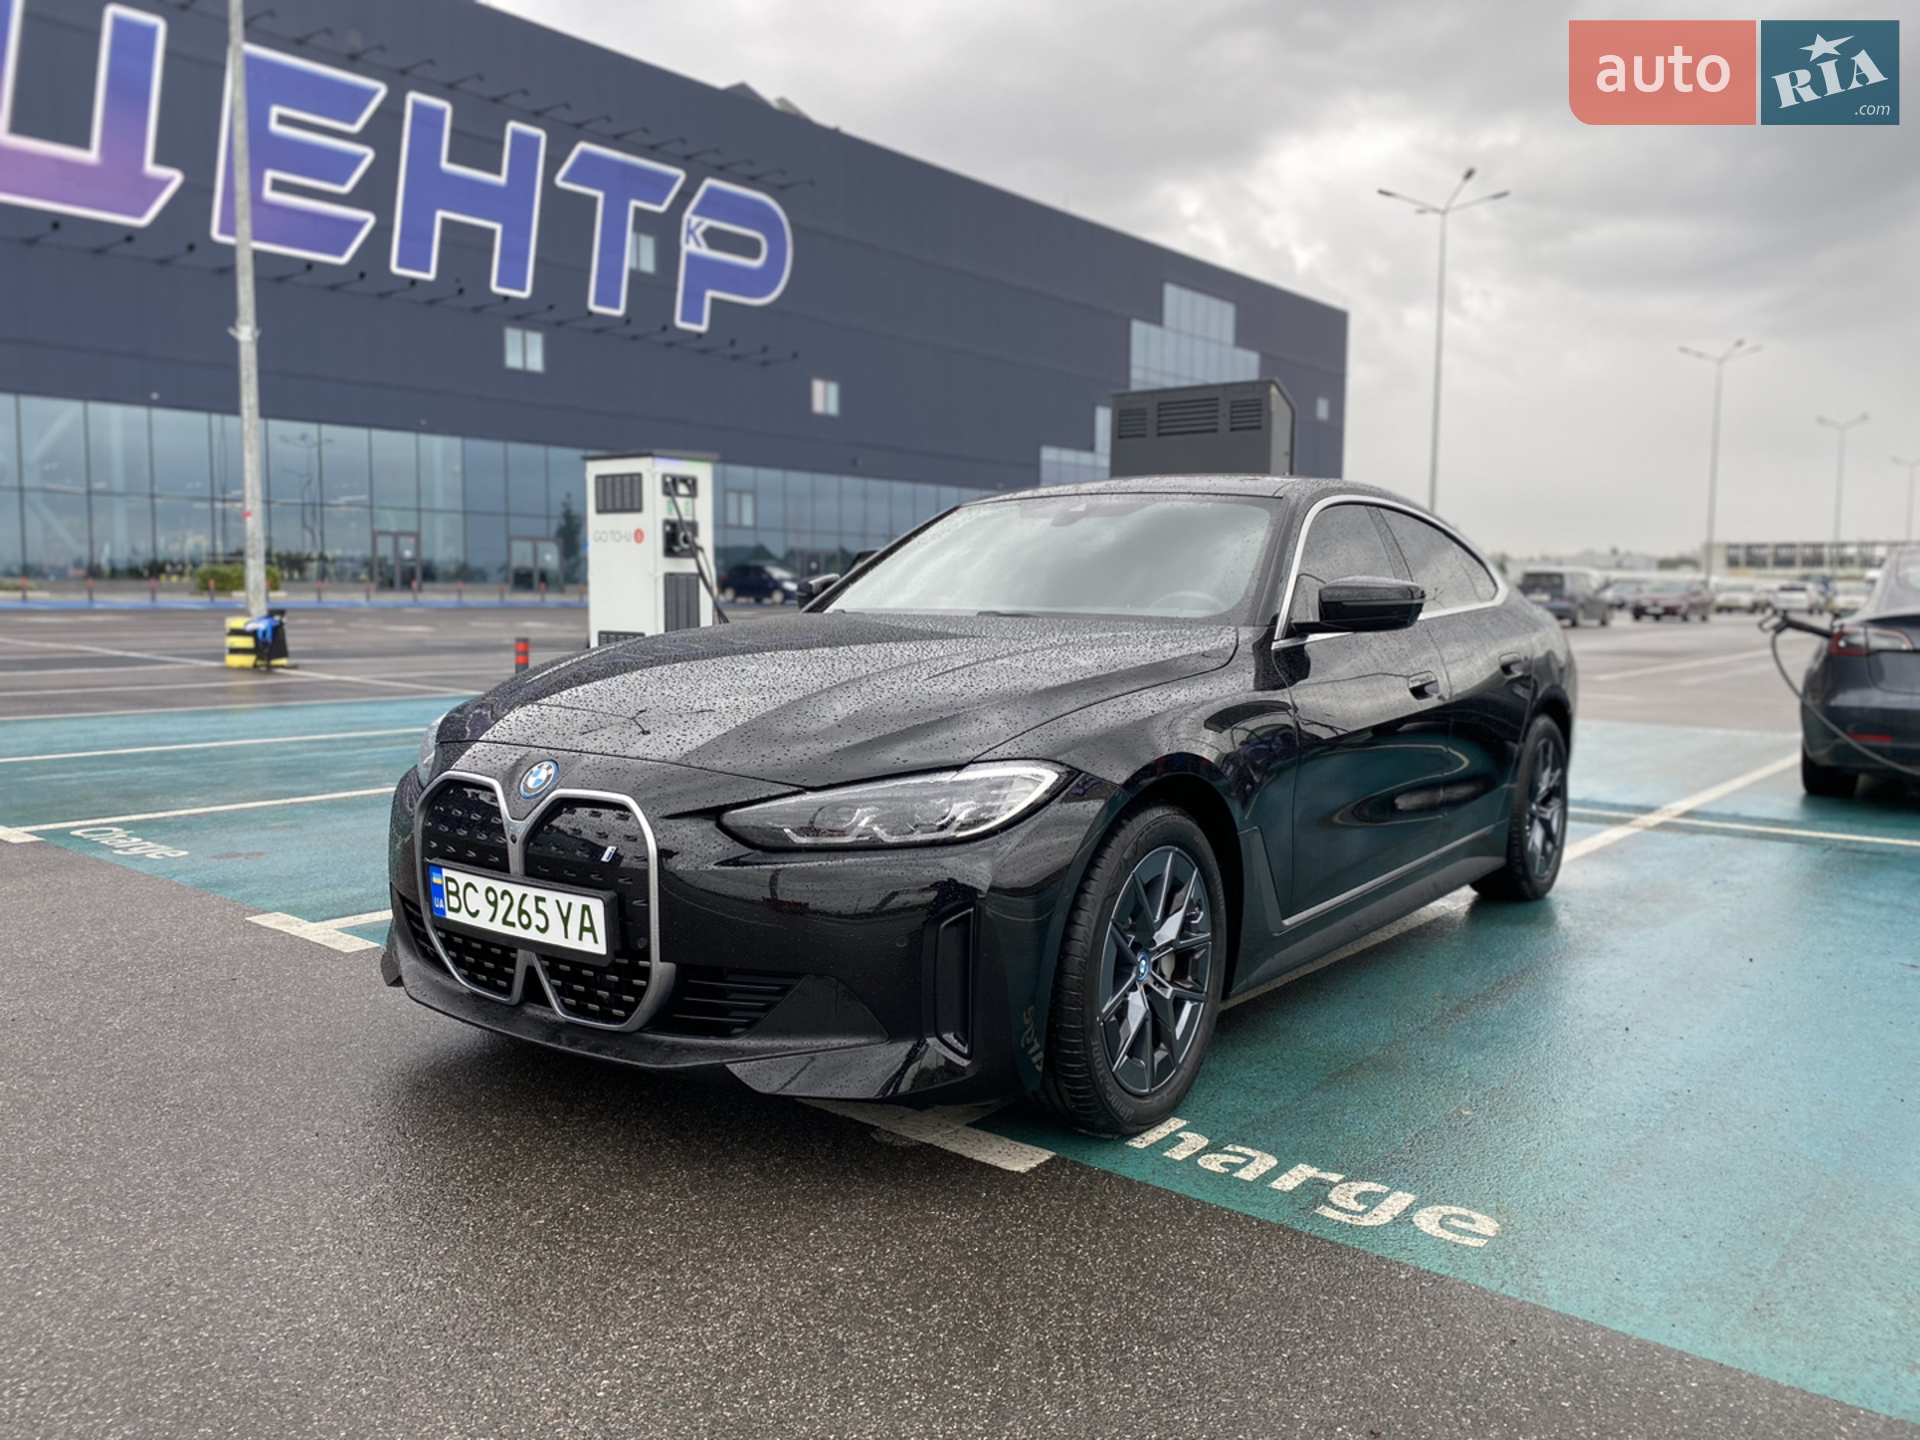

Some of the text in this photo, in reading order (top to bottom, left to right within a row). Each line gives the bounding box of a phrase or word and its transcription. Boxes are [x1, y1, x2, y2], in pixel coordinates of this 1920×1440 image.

[445, 876, 599, 944] BC 9265 YA
[1124, 1116, 1500, 1247] harge
